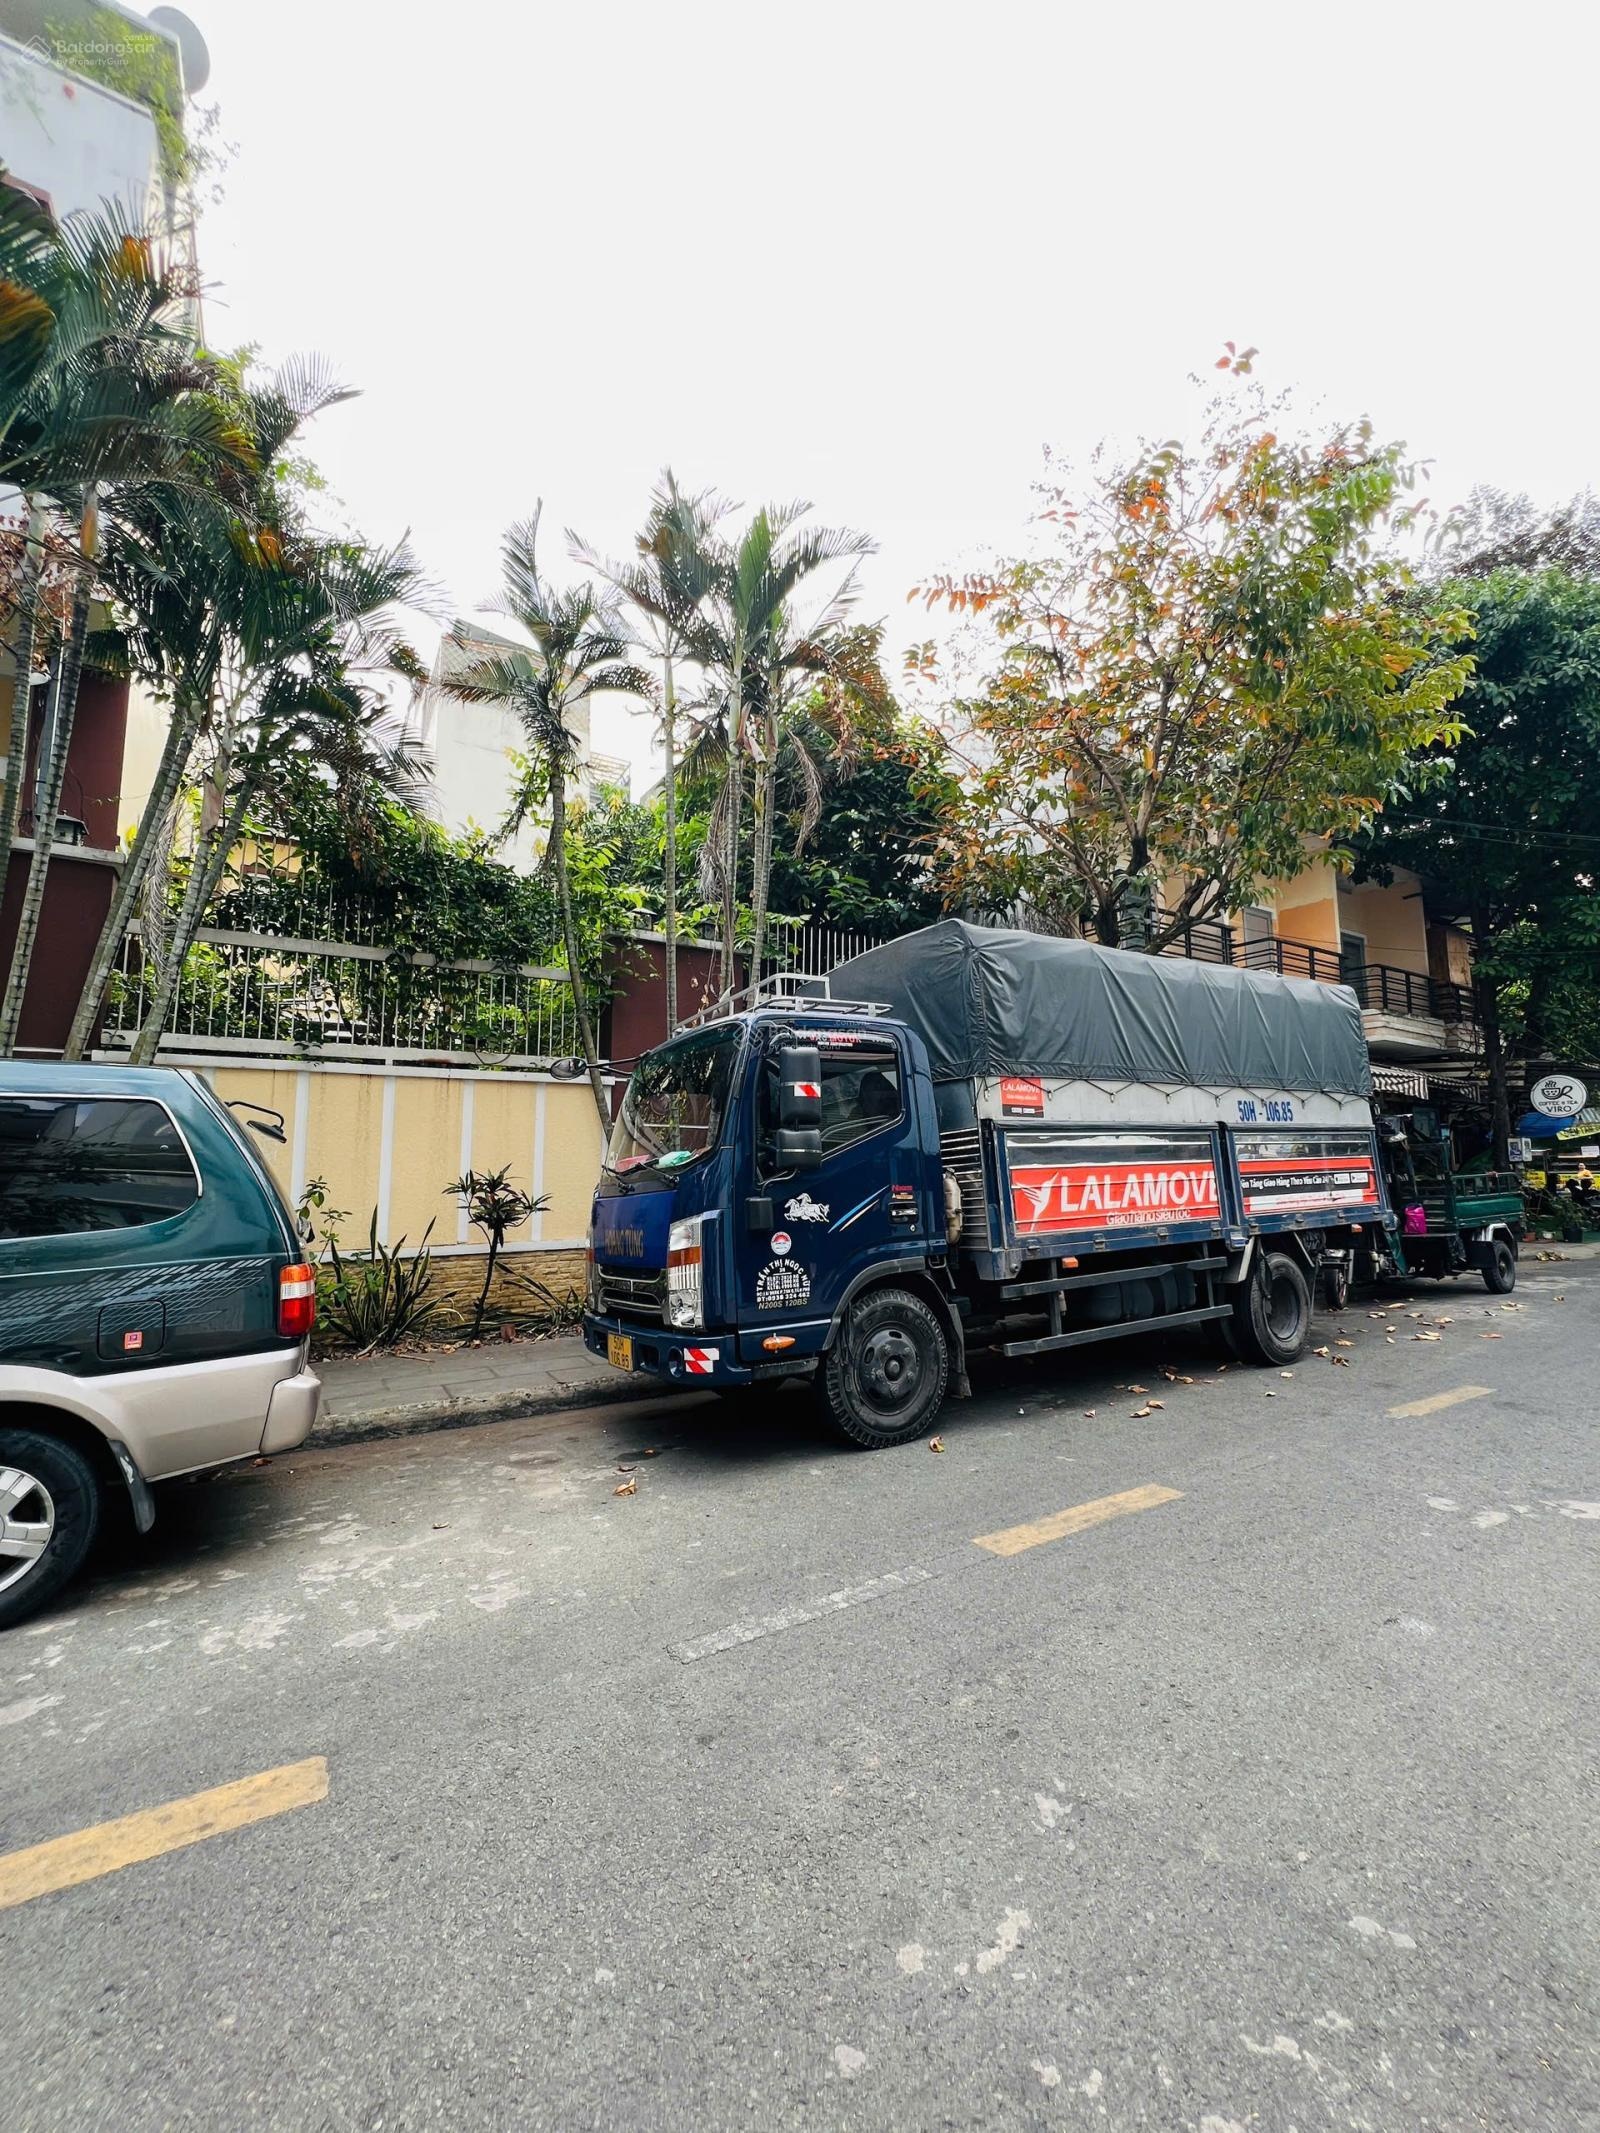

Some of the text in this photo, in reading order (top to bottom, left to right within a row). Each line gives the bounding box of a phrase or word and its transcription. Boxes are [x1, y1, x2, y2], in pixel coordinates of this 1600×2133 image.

[1238, 1100, 1256, 1122] 50H
[1264, 1101, 1293, 1122] 106.85
[784, 1258, 804, 1275] NGỌC
[758, 1301, 783, 1310] N200S
